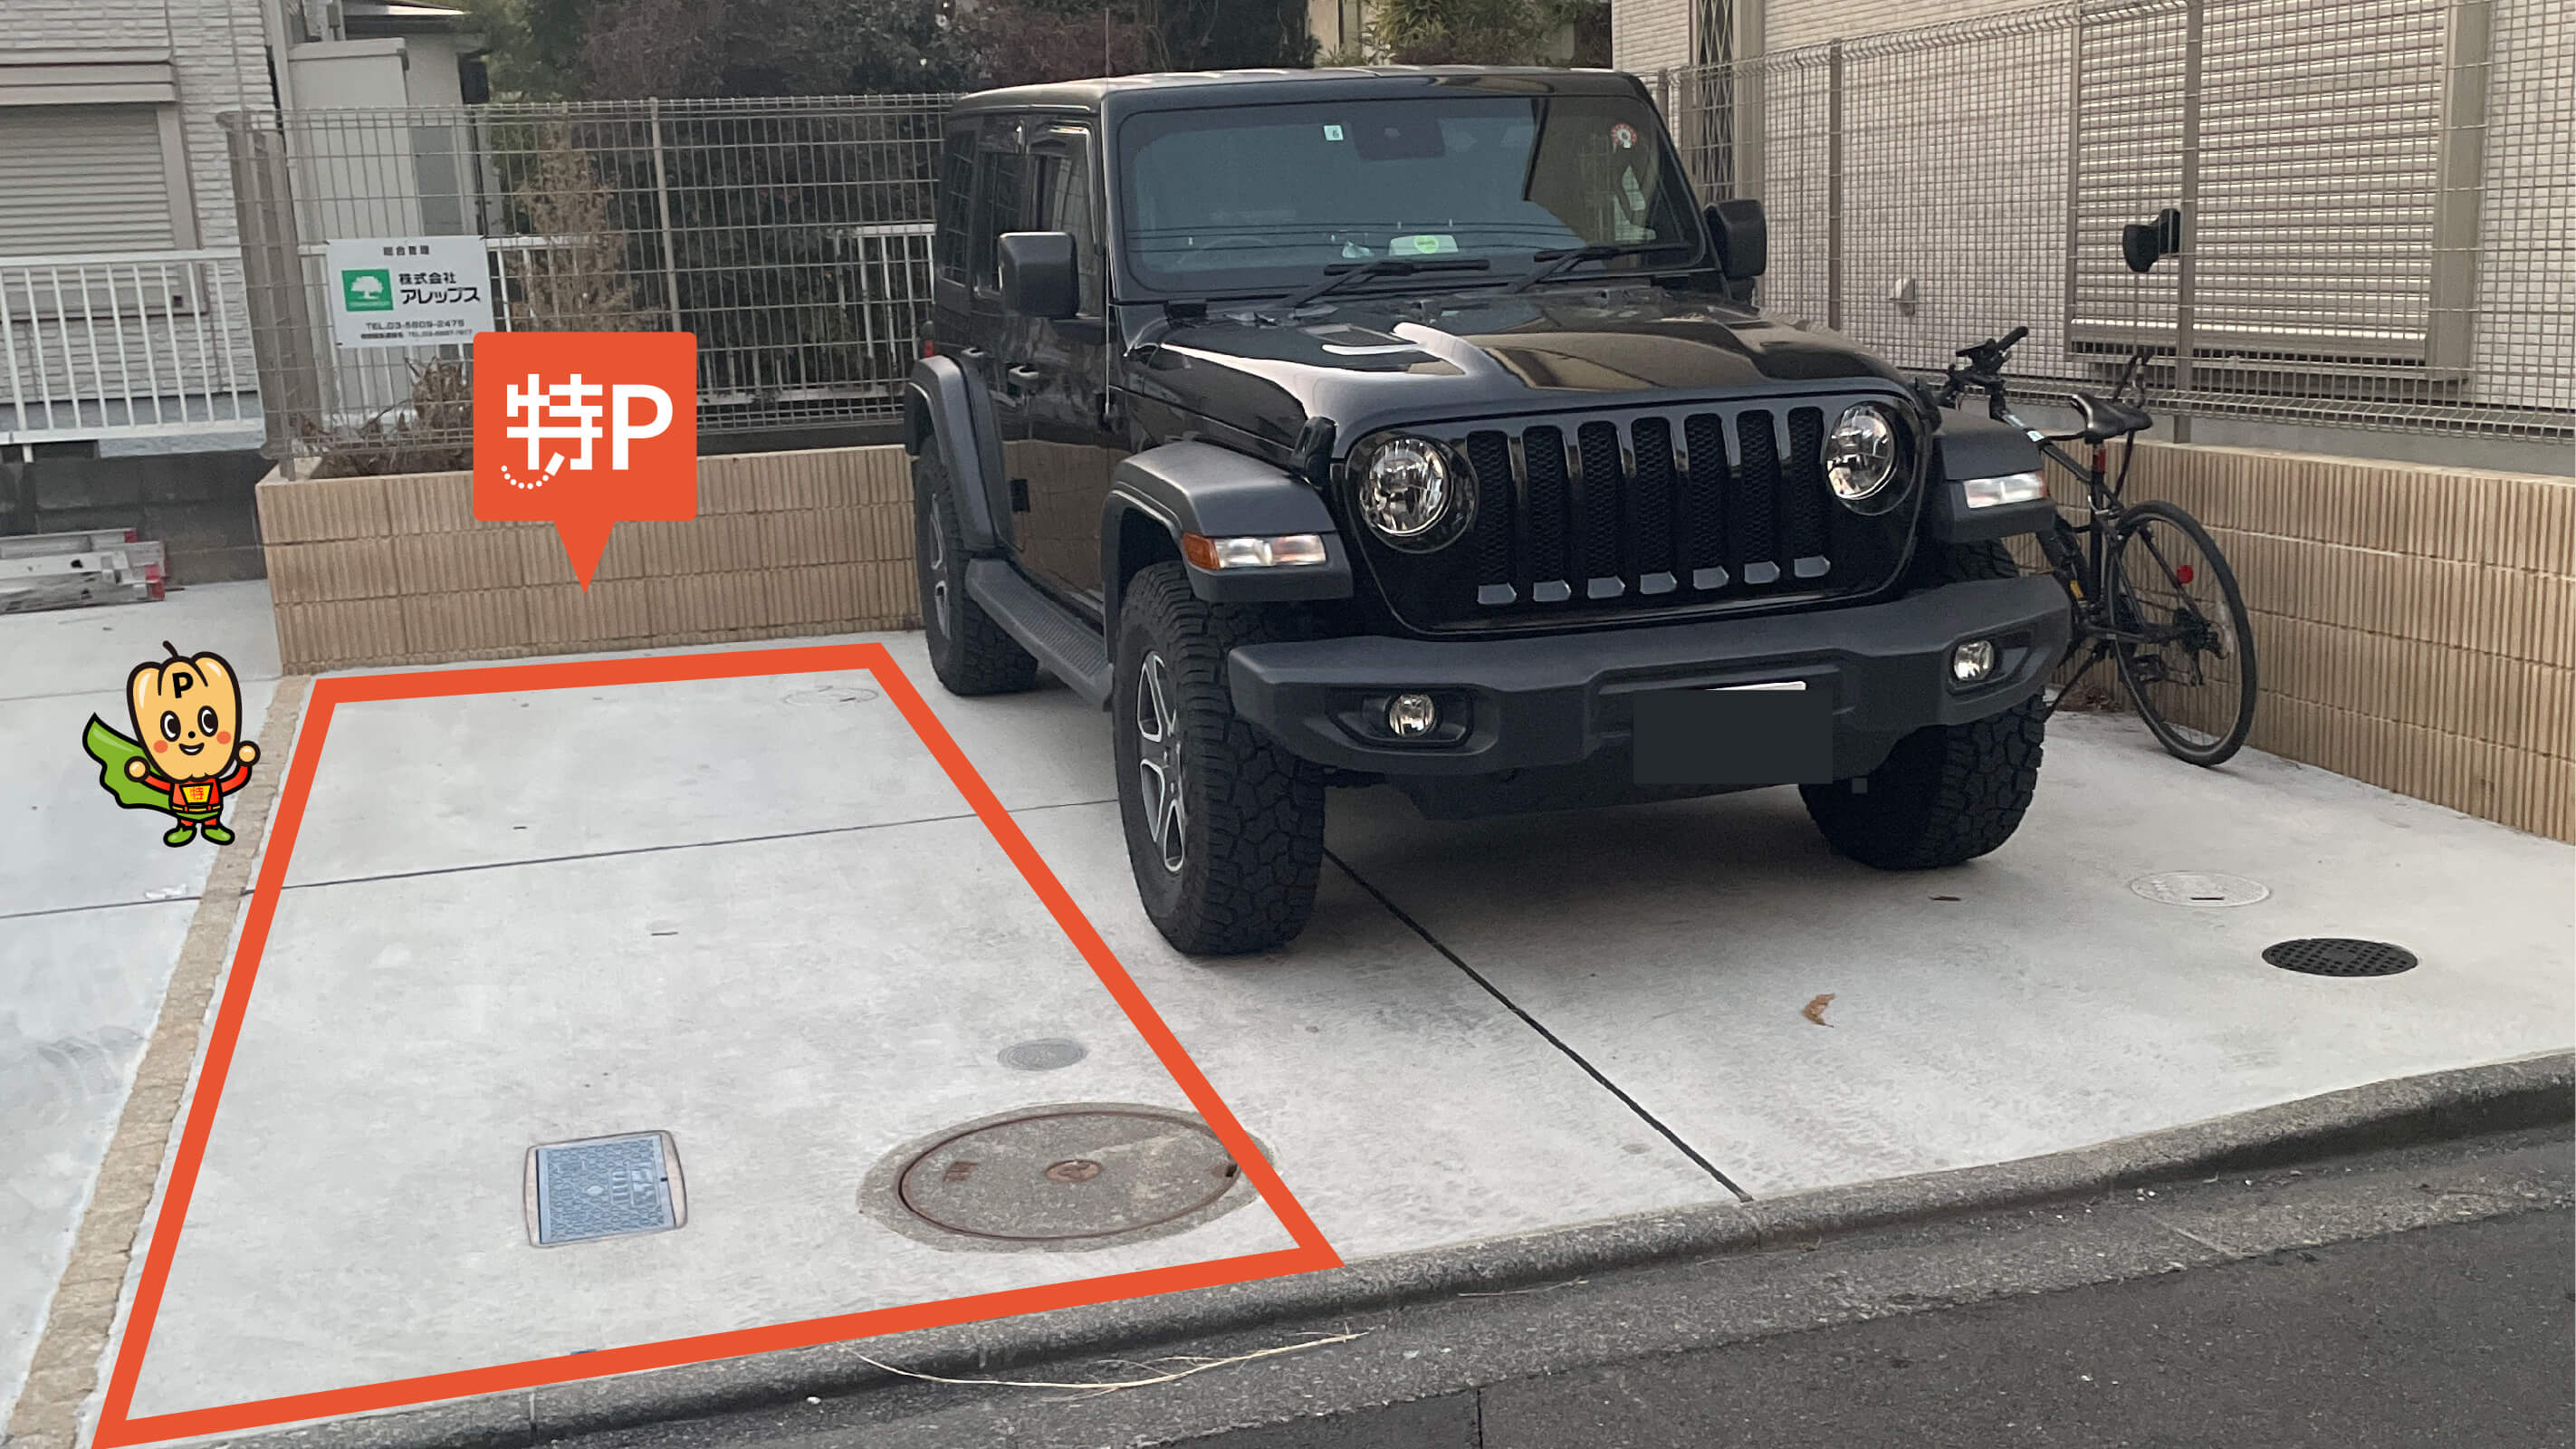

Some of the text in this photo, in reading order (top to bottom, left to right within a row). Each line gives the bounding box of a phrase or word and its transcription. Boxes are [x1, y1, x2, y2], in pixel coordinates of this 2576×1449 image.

[398, 272, 457, 285] 株式会社
[400, 287, 481, 304] アレップス
